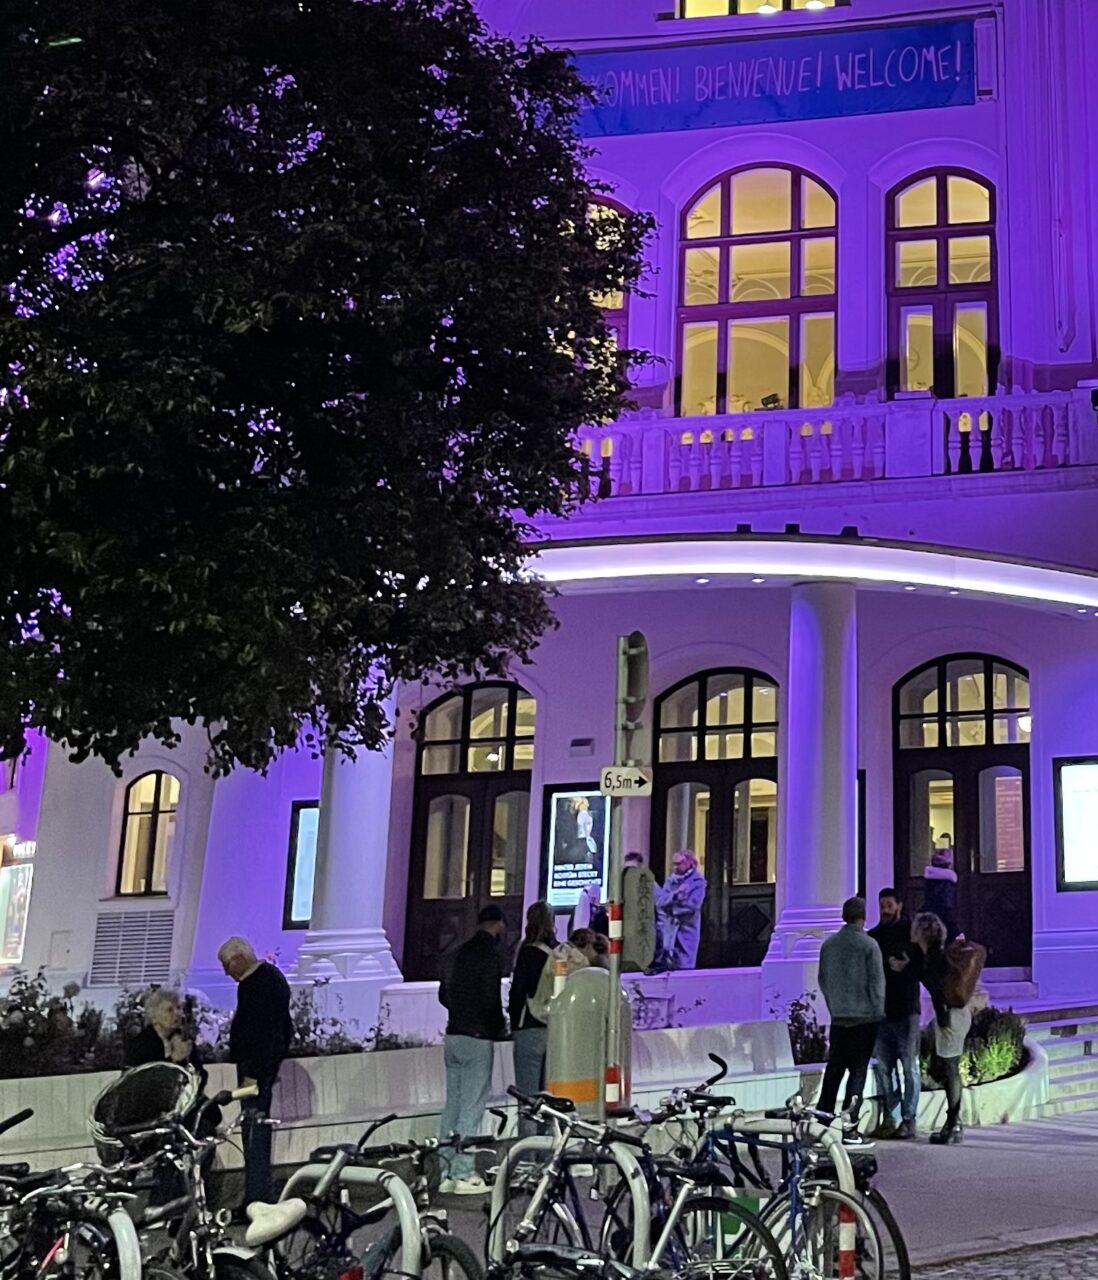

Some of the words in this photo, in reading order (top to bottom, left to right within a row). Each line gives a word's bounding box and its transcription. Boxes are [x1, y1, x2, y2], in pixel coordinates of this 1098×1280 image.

[695, 50, 822, 101] BIENVENUE!
[834, 39, 963, 92] WELCOME!
[604, 771, 632, 792] 6,5m
